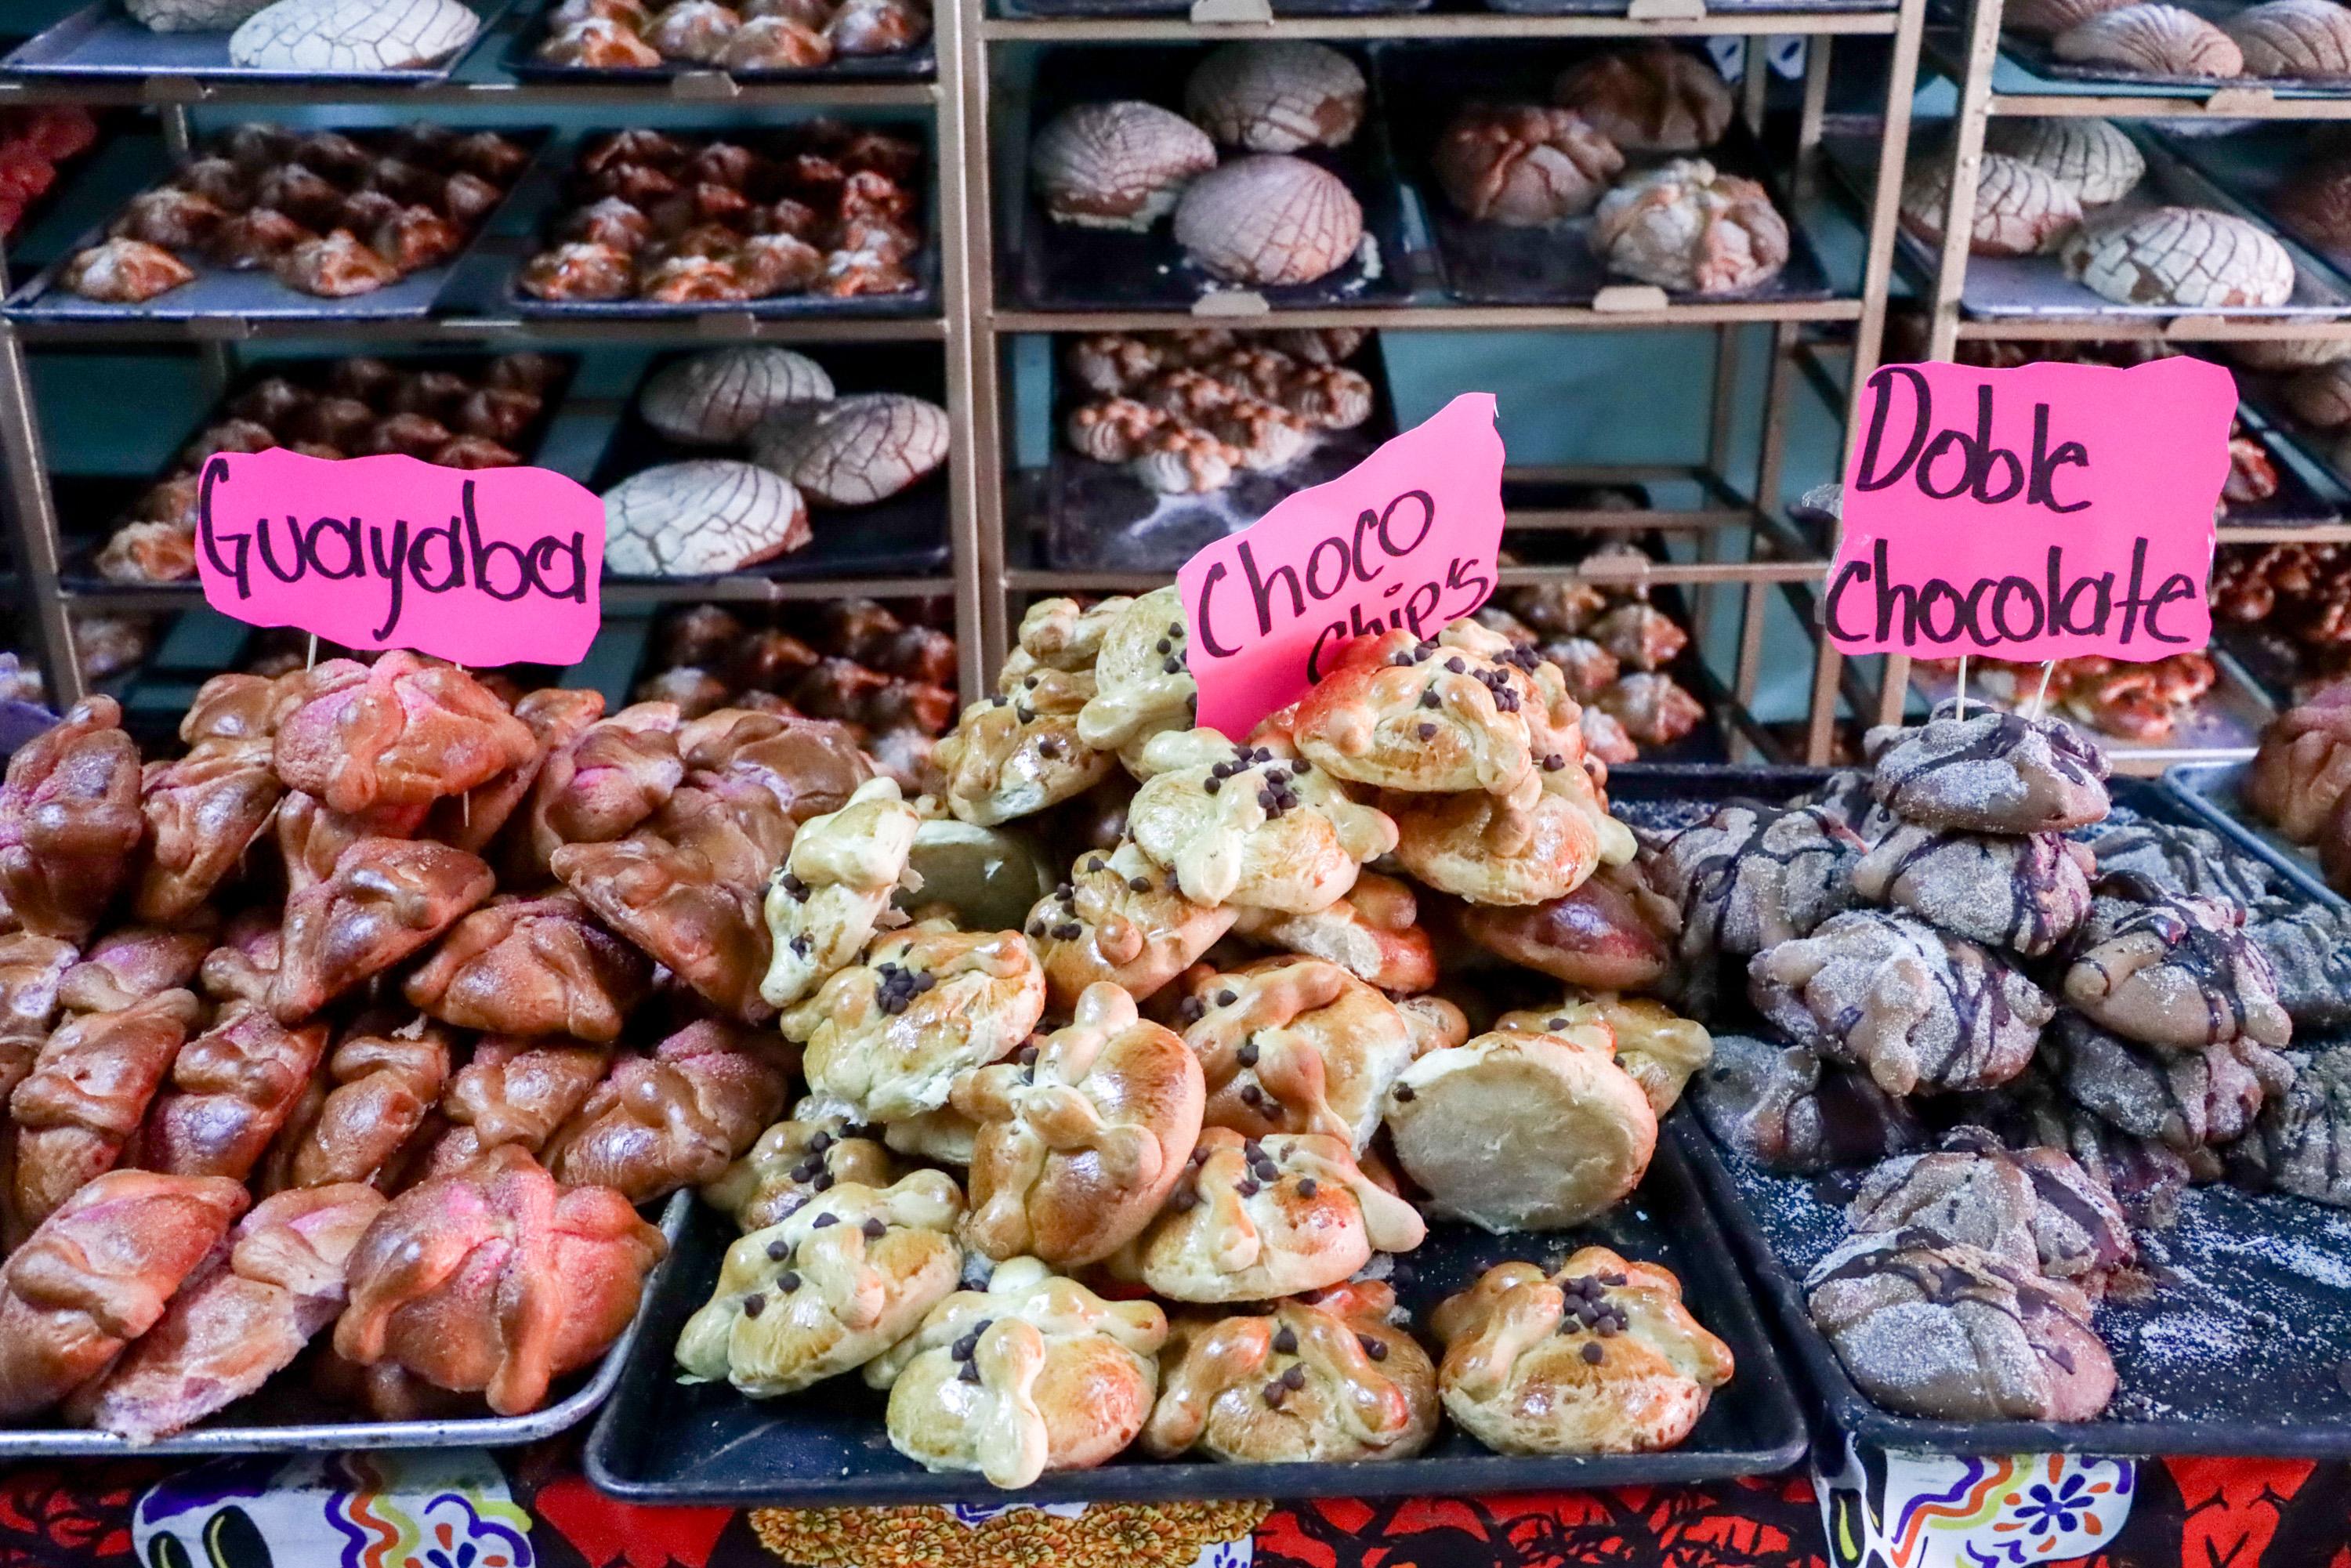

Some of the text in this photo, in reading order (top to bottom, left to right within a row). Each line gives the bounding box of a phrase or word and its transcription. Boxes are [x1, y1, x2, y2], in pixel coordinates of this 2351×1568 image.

[1856, 368, 2092, 512] Doble
[200, 458, 586, 642] Guayaba
[1199, 490, 1435, 657] Choco
